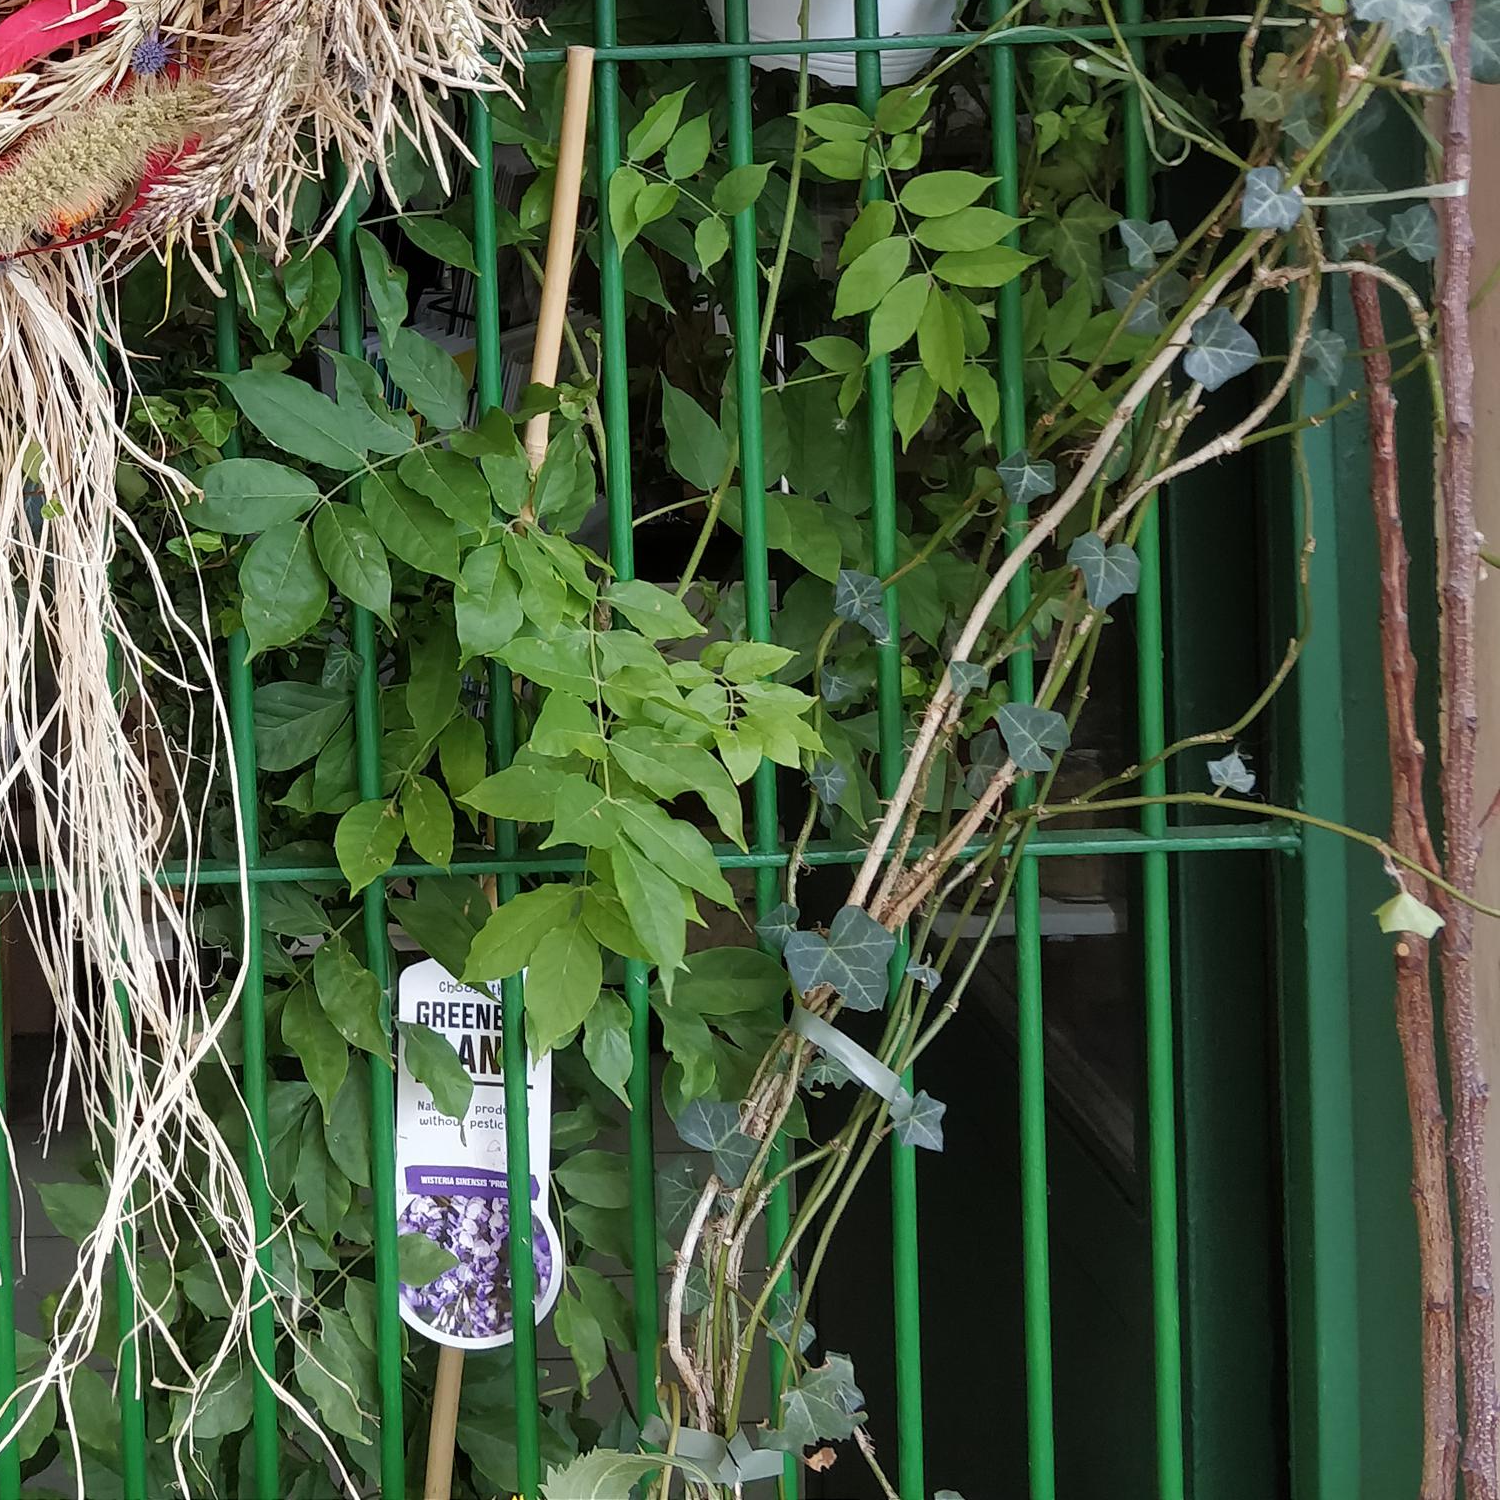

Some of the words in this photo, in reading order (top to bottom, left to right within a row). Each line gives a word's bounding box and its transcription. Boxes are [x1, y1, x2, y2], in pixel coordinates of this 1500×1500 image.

[417, 1001, 503, 1030] GREENE
[420, 1116, 462, 1127] withou
[470, 1119, 504, 1130] pestic
[420, 1175, 455, 1185] WISTERIA
[489, 1179, 508, 1189] 'PROL
